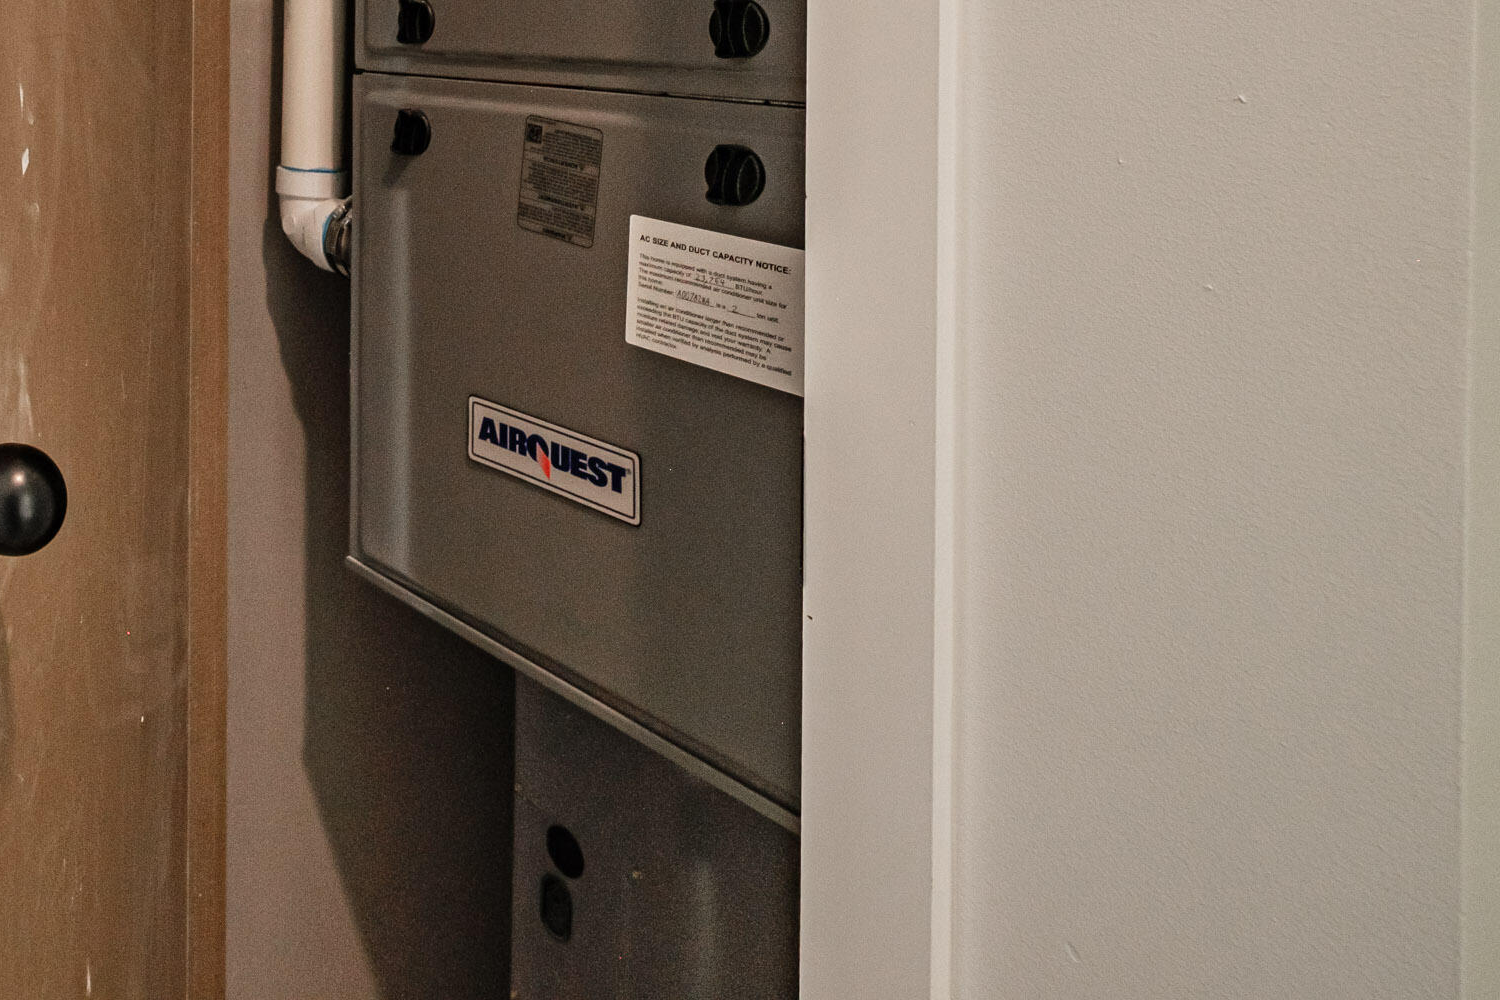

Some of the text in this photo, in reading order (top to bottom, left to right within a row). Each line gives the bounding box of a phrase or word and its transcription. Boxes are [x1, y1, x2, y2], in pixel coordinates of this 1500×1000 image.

[639, 261, 662, 272] maximum
[664, 267, 684, 277] capacity
[640, 235, 792, 275] AC SIZE AND DUCT CAPACITY NOTICE:
[651, 256, 665, 264] home
[672, 261, 695, 271] equipped
[713, 271, 725, 279] duct
[727, 274, 747, 284] system
[748, 279, 767, 289] having
[638, 281, 652, 290] Serial
[649, 271, 674, 281] maximum
[675, 277, 711, 290] recommended
[721, 289, 752, 301] conditioner
[753, 296, 764, 304] unit
[765, 299, 777, 307] size
[637, 305, 662, 316] exceeding
[673, 314, 684, 322] BTU
[686, 318, 709, 329] capacity
[725, 329, 737, 337] duct
[738, 333, 759, 343] system
[760, 339, 773, 347] may
[774, 343, 792, 352] cause
[637, 312, 658, 322] moisture
[659, 318, 677, 328] related
[712, 333, 723, 341] void
[724, 337, 736, 345] your
[637, 319, 655, 329] smaller
[663, 327, 691, 339] conditioner
[692, 335, 704, 343] than
[705, 339, 744, 355] recommended
[746, 351, 758, 359] may
[638, 298, 659, 308] Installing
[676, 308, 704, 320] conditioner
[705, 316, 721, 325] larger
[723, 321, 734, 329] than
[736, 324, 777, 341] recommended
[637, 326, 656, 336] installed
[658, 332, 671, 341] when
[673, 337, 691, 347] verified
[700, 345, 722, 356] analysis
[723, 352, 752, 365] performed
[767, 364, 792, 377] qualified
[478, 416, 626, 494] AIRQUEST
